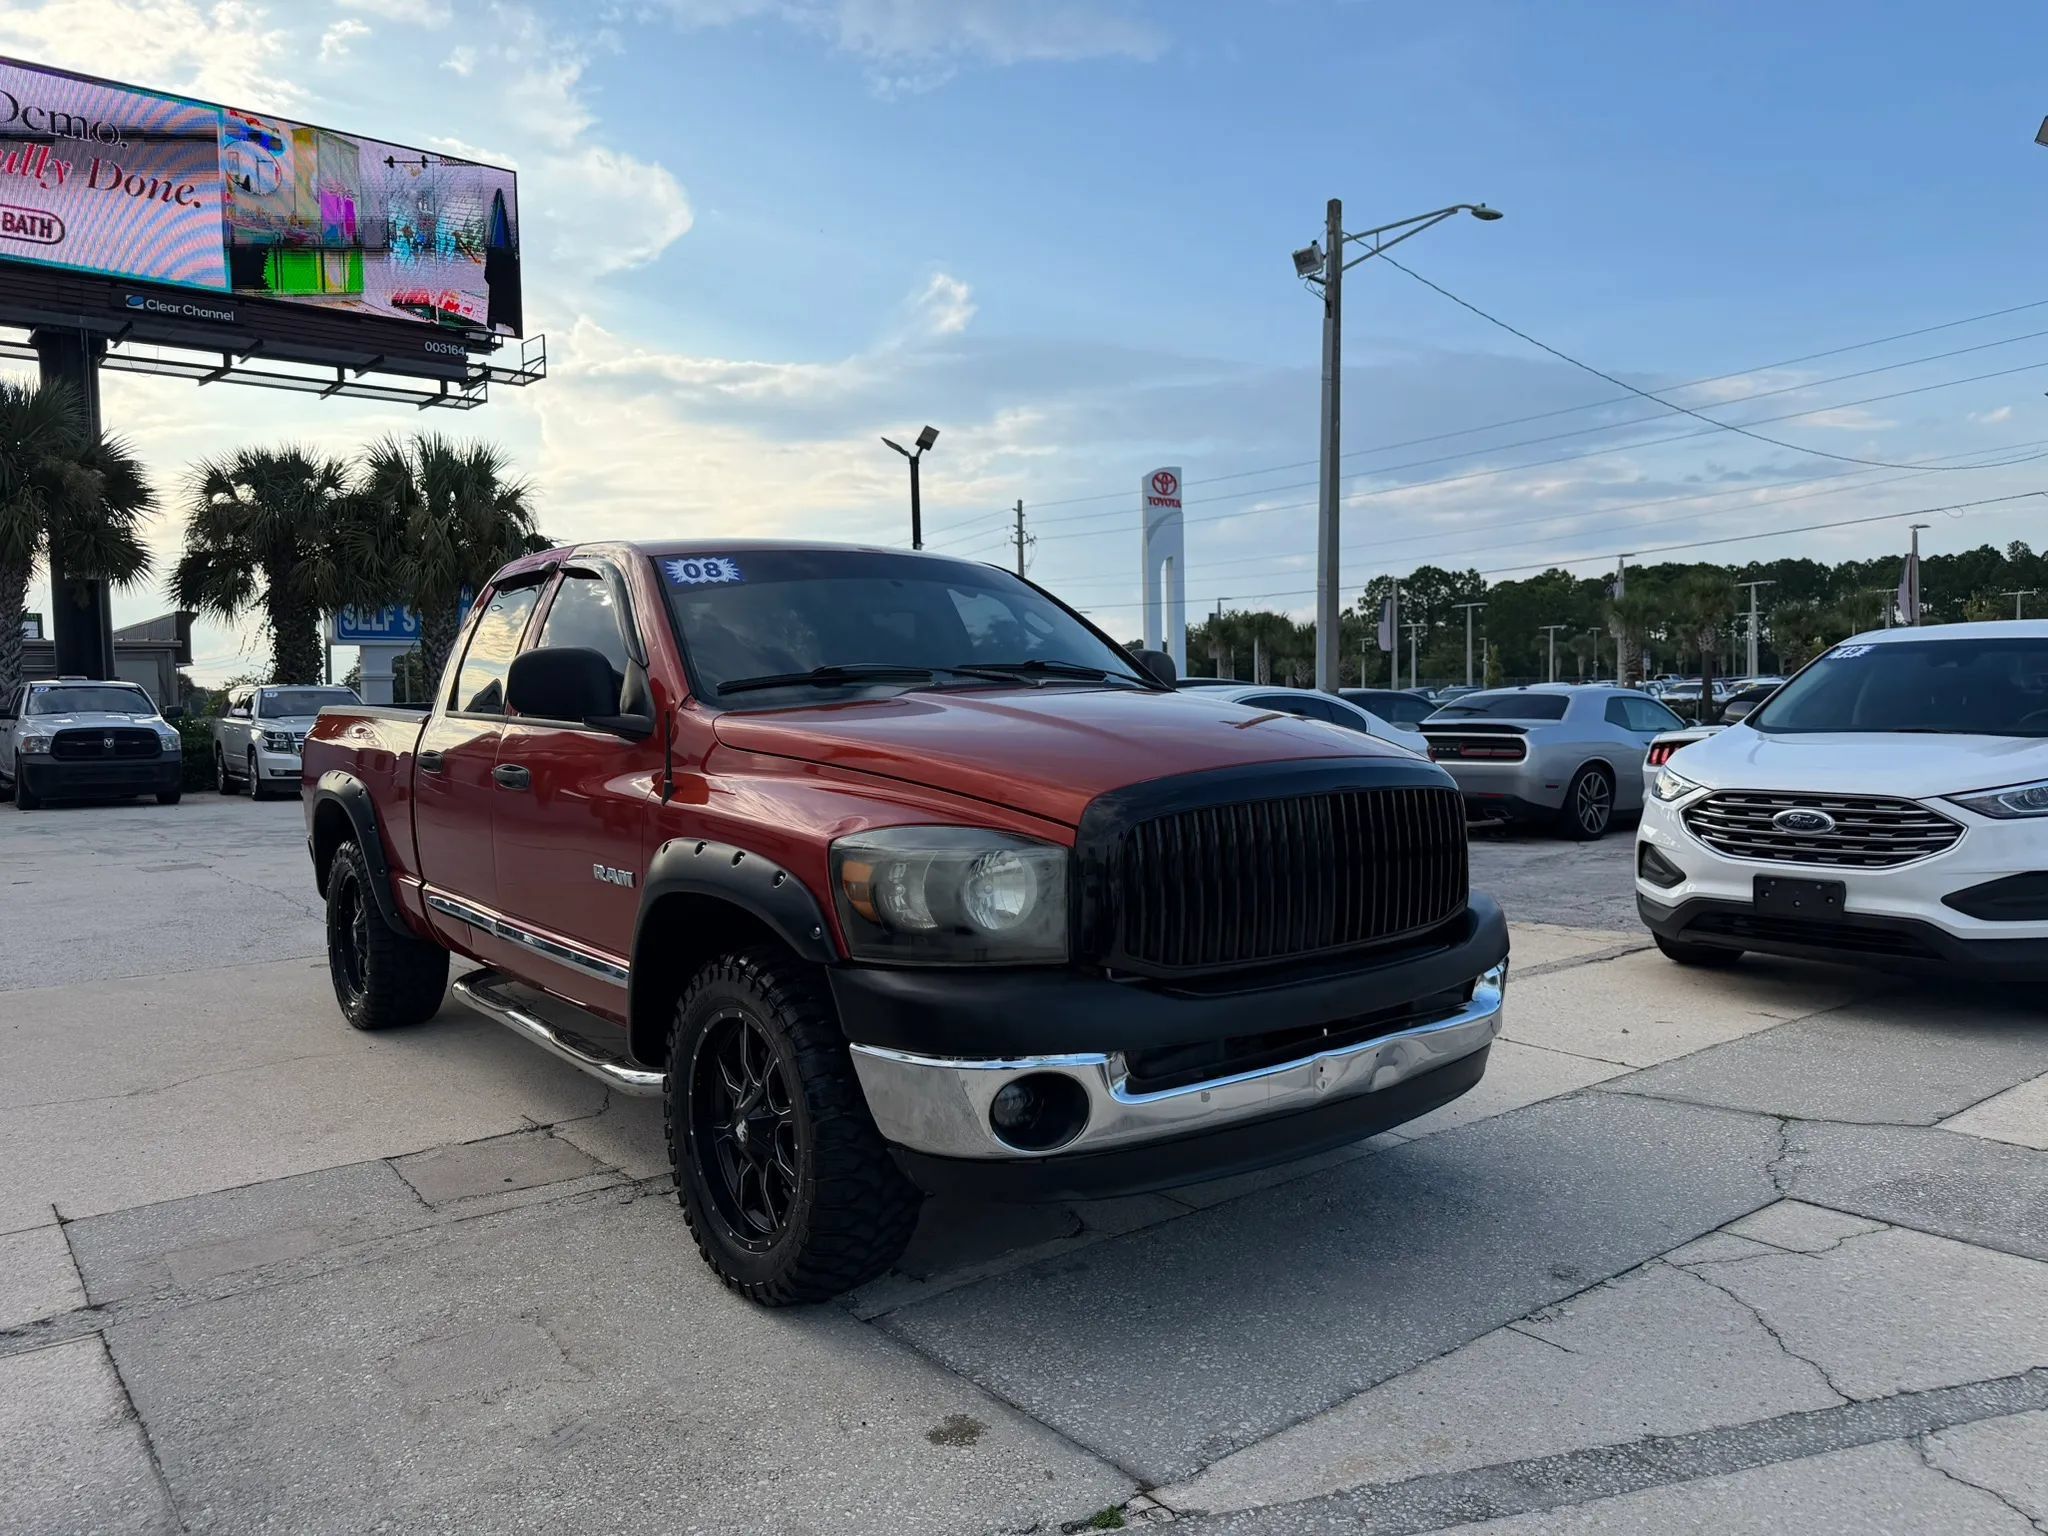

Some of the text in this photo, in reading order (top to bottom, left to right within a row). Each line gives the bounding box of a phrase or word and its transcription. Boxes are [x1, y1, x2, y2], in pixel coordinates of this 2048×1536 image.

[87, 155, 201, 209] Done.
[2, 210, 54, 239] BATH
[146, 299, 235, 321] Clear Channel
[424, 341, 466, 356] 003164
[1147, 495, 1182, 509] TOYOTA
[682, 561, 722, 579] 08
[1785, 813, 1819, 828] Ford
[593, 863, 634, 889] RAM
